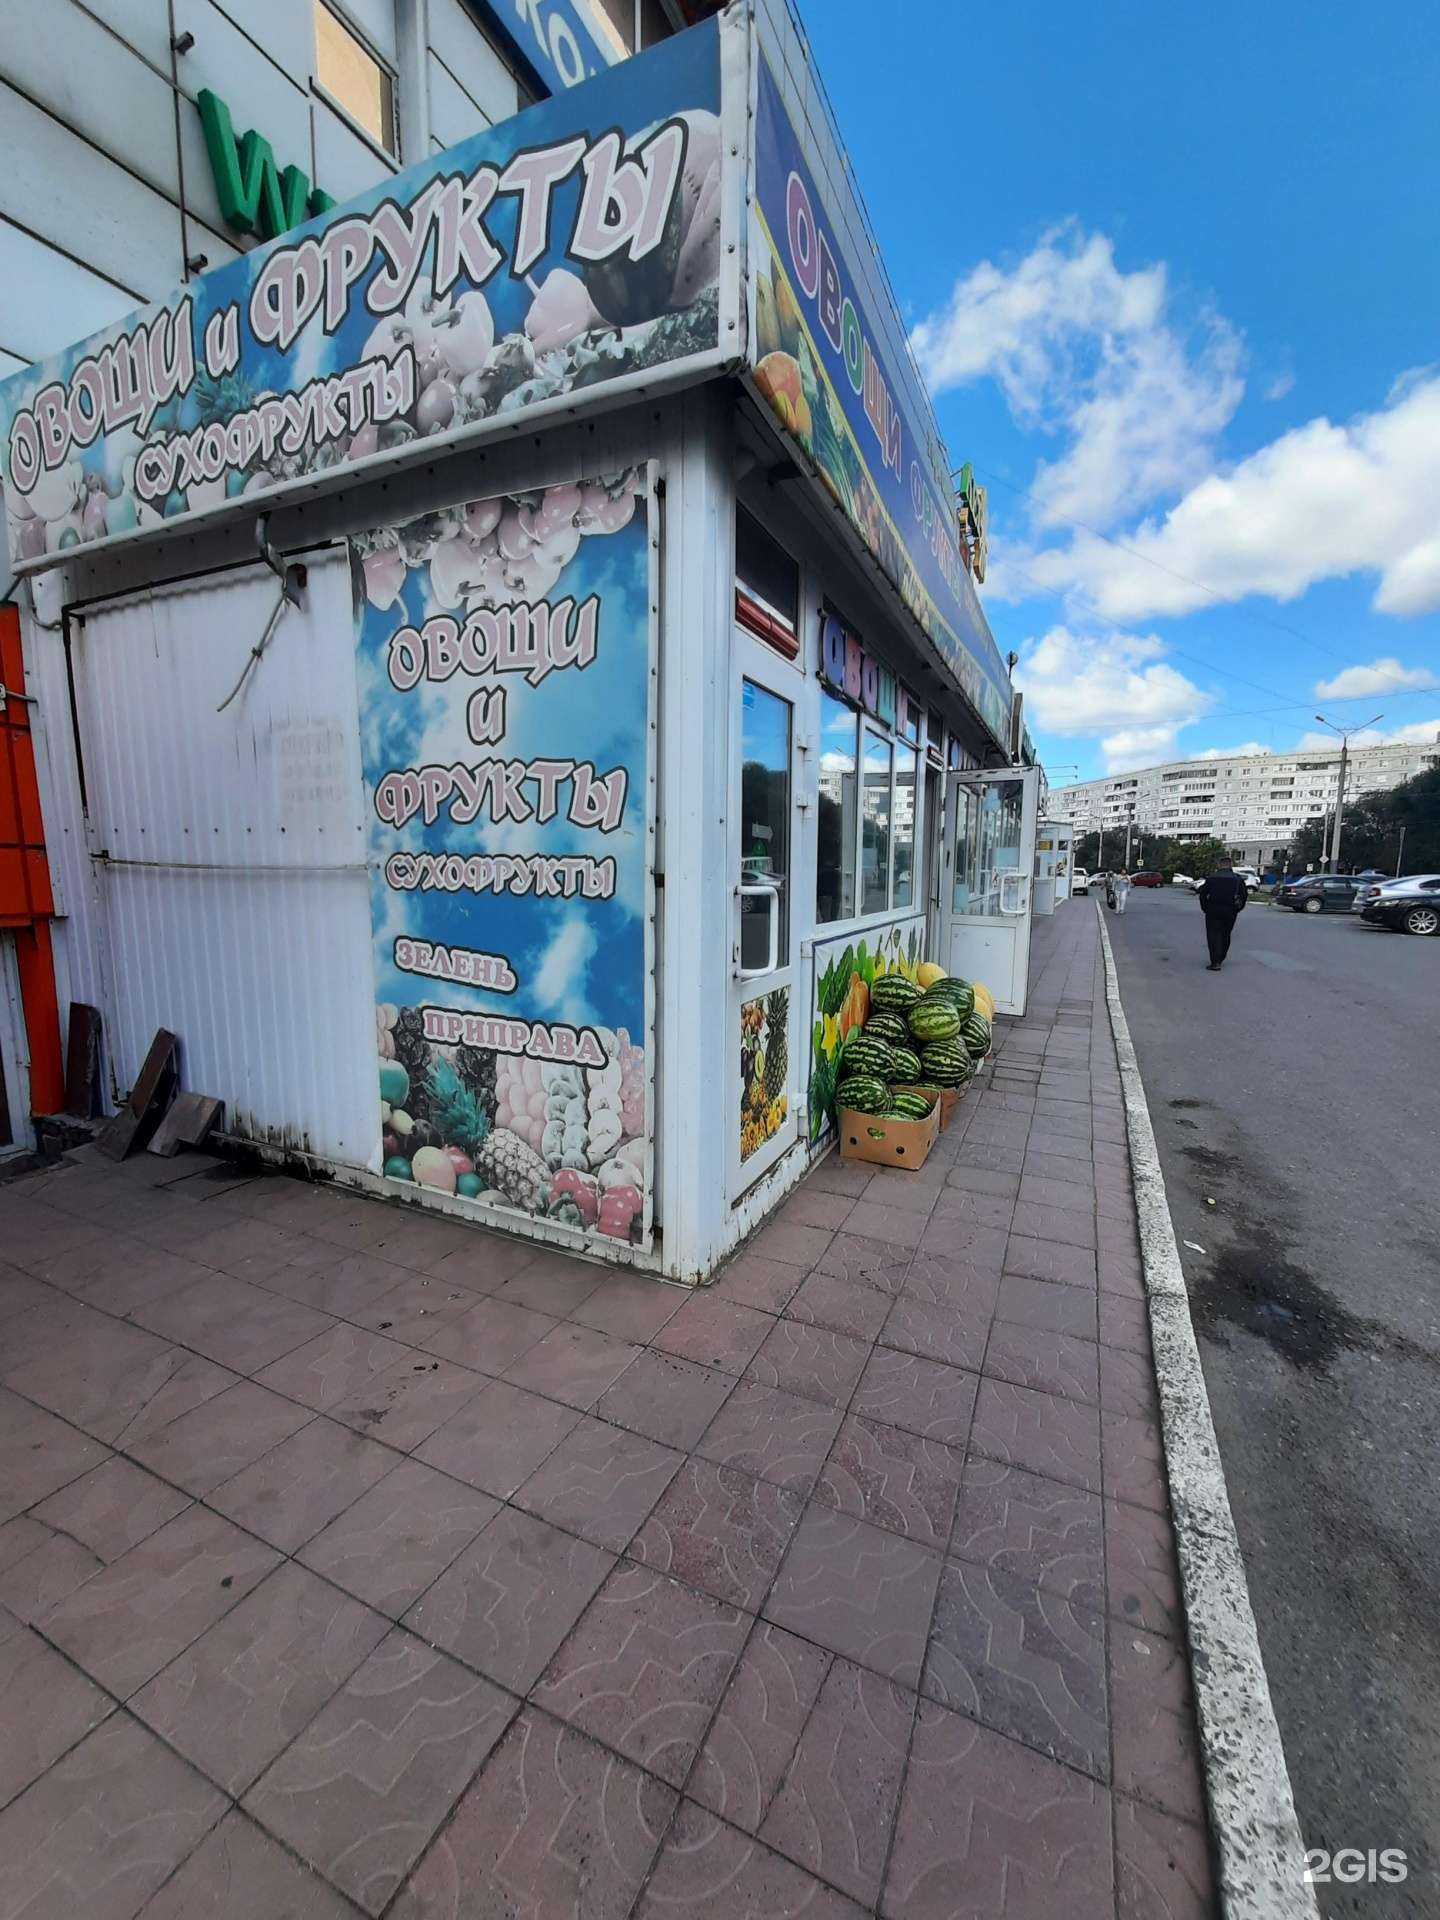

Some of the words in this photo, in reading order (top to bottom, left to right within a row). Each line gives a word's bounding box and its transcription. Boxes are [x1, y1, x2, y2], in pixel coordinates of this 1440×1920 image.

[8, 293, 194, 495] ОВОЩИ
[250, 118, 689, 353] ФРУКТЫ
[787, 171, 901, 482] ОВОЩИ
[136, 346, 418, 499] СУХОФРУКТЫ
[387, 594, 600, 690] ОВОЩИ
[376, 759, 628, 833] ФРУКТЫ
[386, 852, 616, 898] СУХОФРУКТЫ
[395, 938, 516, 991] ЗЕЛЕНЬ
[422, 1009, 604, 1065] ПРИПРАВА
